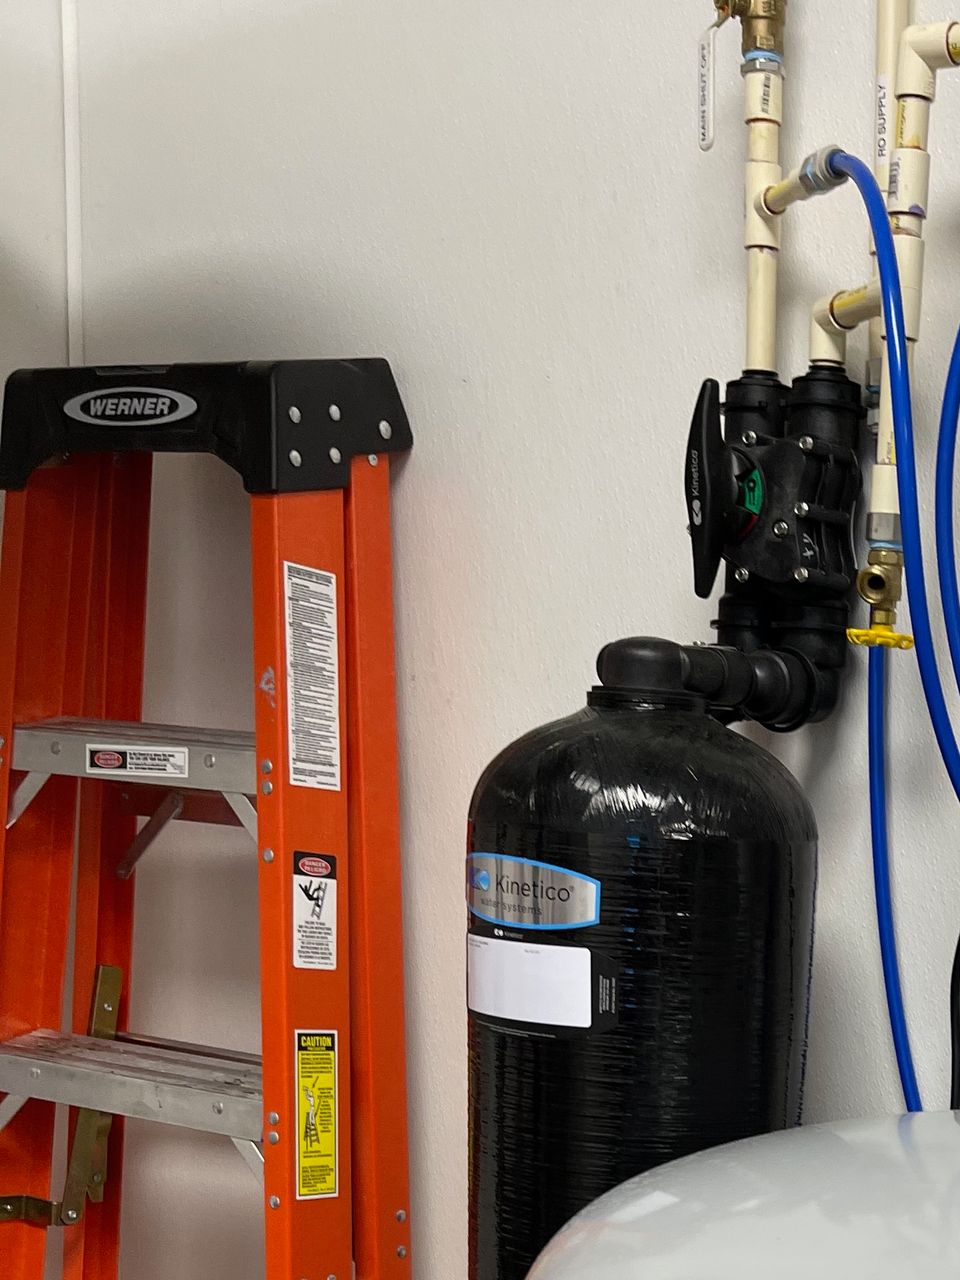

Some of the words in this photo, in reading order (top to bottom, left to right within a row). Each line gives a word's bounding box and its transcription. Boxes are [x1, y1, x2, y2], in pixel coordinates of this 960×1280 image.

[877, 84, 887, 135] SUPPLY
[877, 138, 887, 158] RO
[89, 397, 171, 416] WERNER
[495, 873, 571, 903] Kinetico
[502, 902, 543, 916] systems
[301, 1035, 333, 1047] CAUTION
